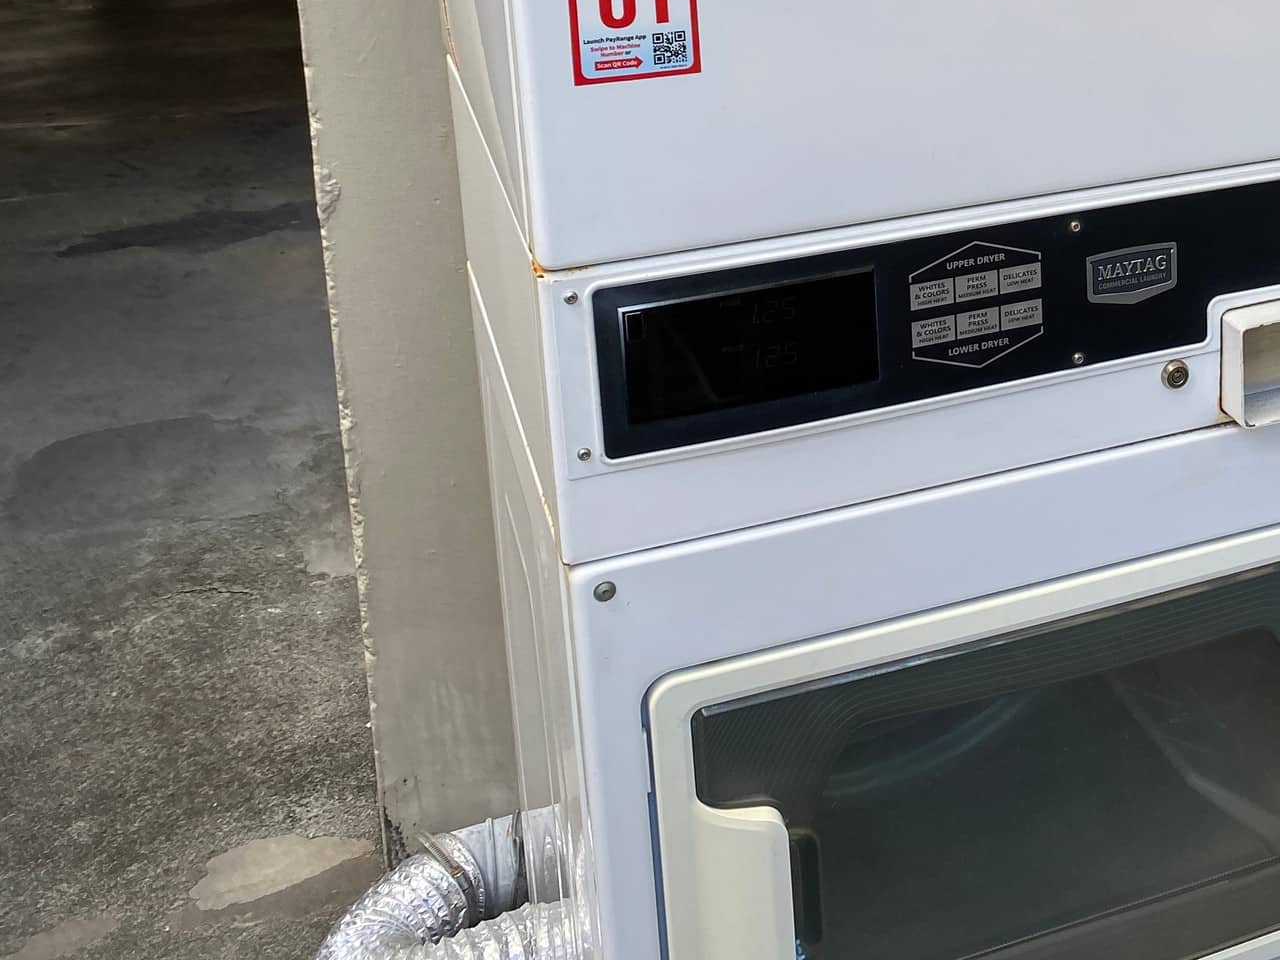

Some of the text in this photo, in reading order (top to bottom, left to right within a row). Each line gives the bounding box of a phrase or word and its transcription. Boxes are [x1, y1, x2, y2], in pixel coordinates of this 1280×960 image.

[606, 35, 634, 43] PayRange
[946, 252, 1006, 271] UPPER DRYER
[1097, 254, 1168, 281] MAYTAG
[967, 274, 986, 284] PERM
[1003, 269, 1038, 281] DELICATES
[966, 281, 988, 291] PRESS
[1020, 277, 1034, 285] HEAT
[1098, 276, 1138, 290] COMMERCIAL
[918, 282, 946, 292] WHITES
[922, 288, 950, 299] COLORS
[958, 287, 997, 299] MEDIUM HEAT
[968, 311, 988, 321] PERM
[1004, 305, 1039, 318] DELICATES
[919, 319, 947, 330] WHITES
[967, 318, 989, 328] PRESS
[923, 325, 951, 336] COLORS
[959, 324, 998, 336] MEDIUM HEAT
[948, 337, 1010, 357] LOWER DRYER
